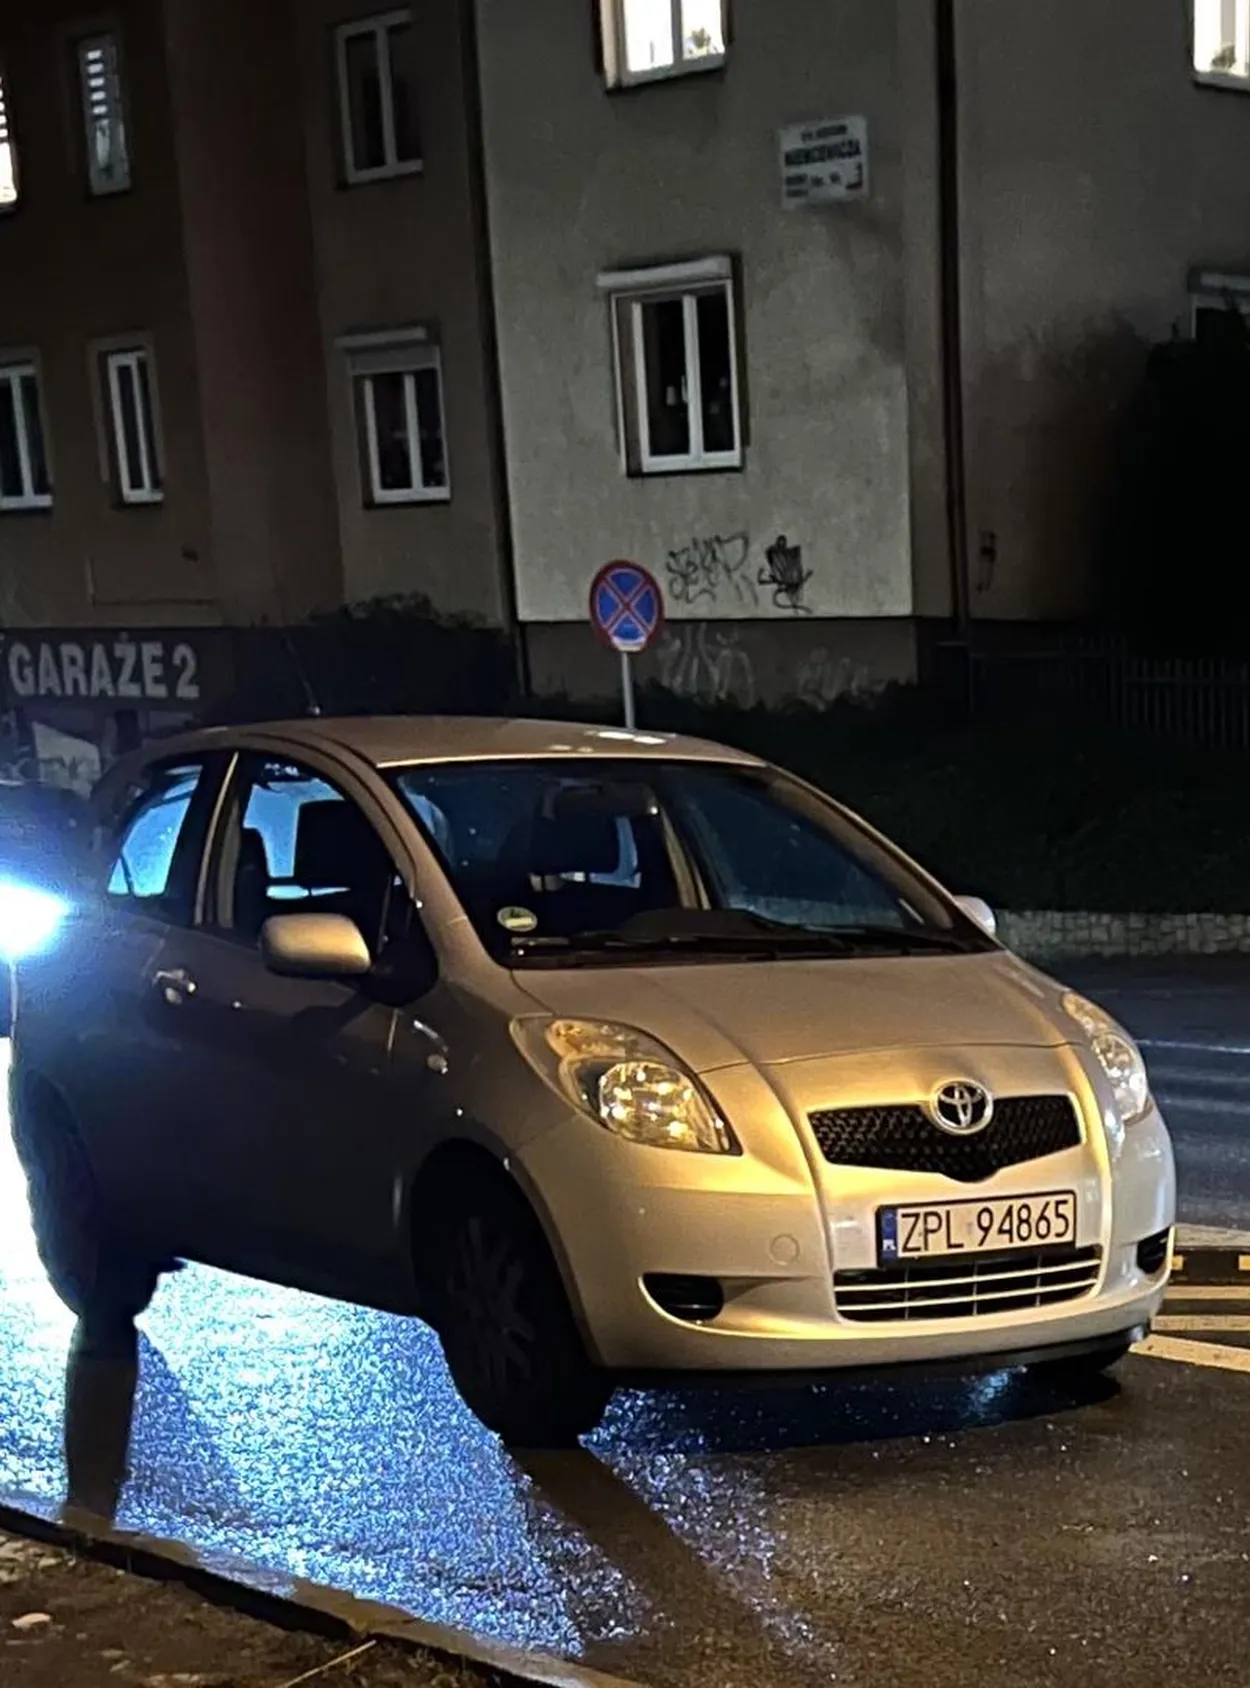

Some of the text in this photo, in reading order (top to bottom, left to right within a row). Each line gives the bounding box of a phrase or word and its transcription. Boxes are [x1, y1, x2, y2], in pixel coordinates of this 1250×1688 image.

[8, 631, 200, 698] GARAŻE 2
[901, 1200, 1070, 1252] ZPL 94865
